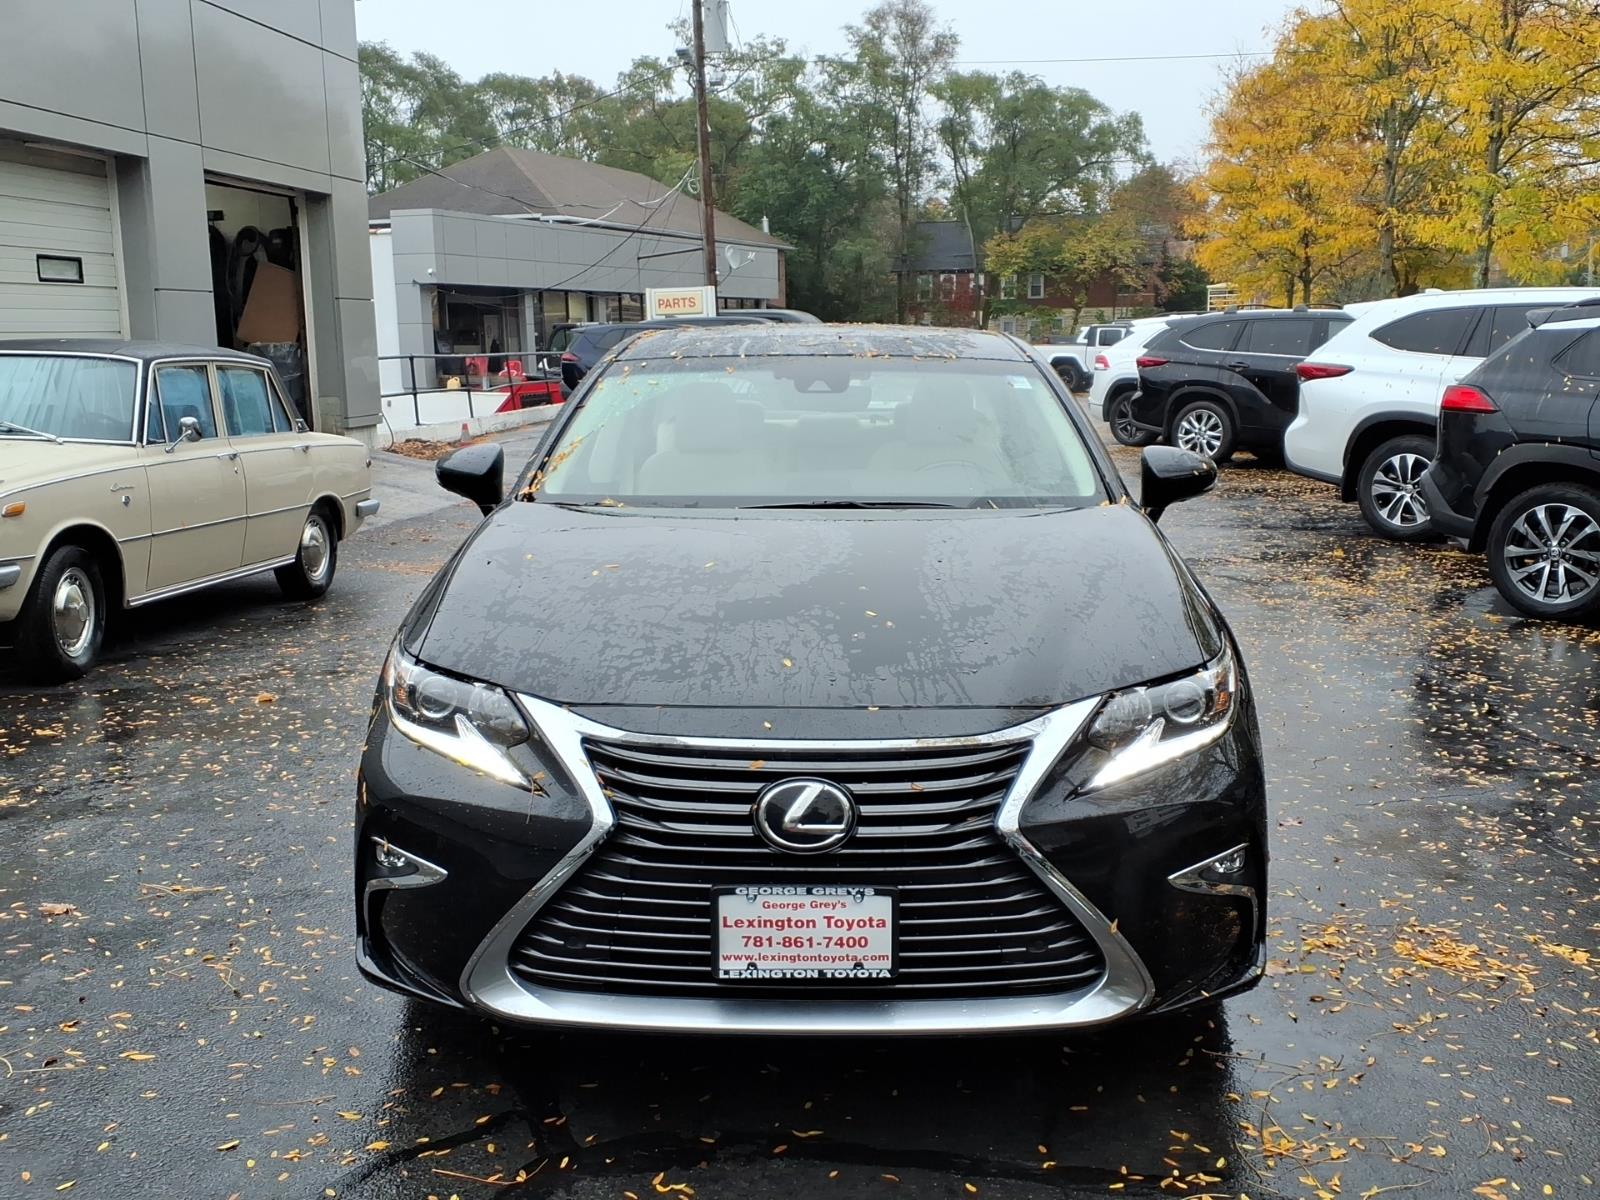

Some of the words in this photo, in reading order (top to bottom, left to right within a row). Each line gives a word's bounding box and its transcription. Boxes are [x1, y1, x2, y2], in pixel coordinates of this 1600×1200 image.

[657, 297, 696, 309] PARTS
[735, 887, 807, 896] GEORGE
[811, 887, 875, 896] GREY'S
[762, 901, 806, 911] George
[810, 900, 847, 910] Grey's
[722, 916, 817, 931] Lexington
[823, 916, 887, 931] Toyota
[741, 936, 869, 948] 781-861-7400
[722, 952, 890, 963] www.lexingtontoyota.com
[719, 969, 818, 978] LEXINGTON
[823, 969, 891, 978] TOYOTA
